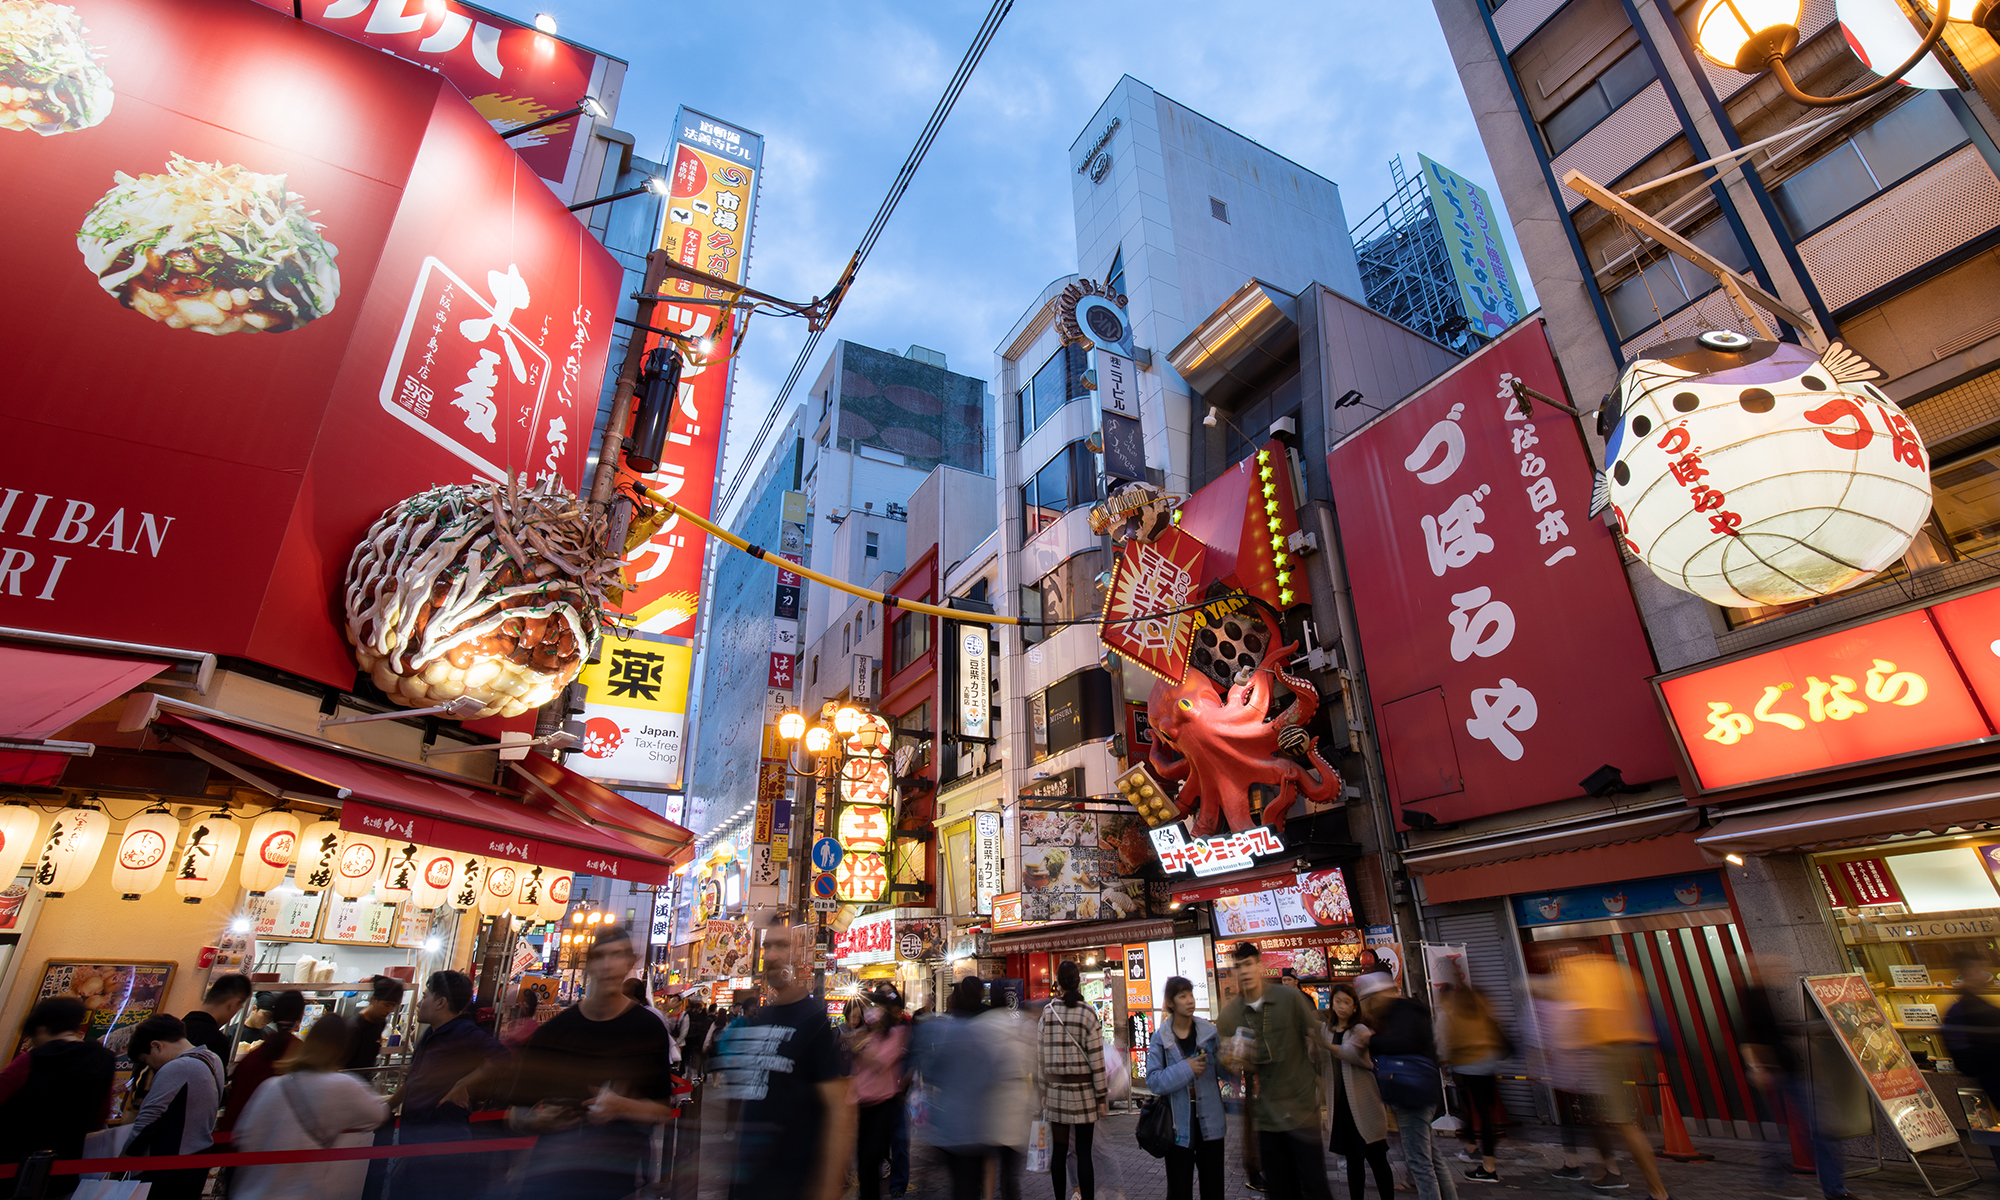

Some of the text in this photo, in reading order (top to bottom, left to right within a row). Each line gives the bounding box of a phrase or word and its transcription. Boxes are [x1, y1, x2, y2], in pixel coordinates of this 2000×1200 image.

[418, 283, 455, 380] 大阪西中島本店
[1657, 419, 1743, 538] づぼらや
[1107, 488, 1149, 514] MUSEUM
[1405, 402, 1538, 761] づぼらや
[782, 595, 794, 606] 刀
[606, 648, 666, 702] 薬
[773, 656, 791, 687] はや
[969, 659, 980, 708] 豆柴カフェ
[1703, 658, 1929, 746] ふぐなら
[634, 737, 678, 752] Tax-free
[640, 725, 679, 738] Japan.
[648, 751, 677, 764] Shop
[308, 833, 338, 888] たこ焼
[983, 838, 993, 889] 豆柴カフェ
[1160, 830, 1281, 871] コナモンミュージアム
[457, 858, 479, 906] たこ焼
[814, 901, 836, 910] 自動車
[1261, 937, 1303, 950] 自由席あります
[1307, 937, 1317, 946] Eat
[1323, 937, 1340, 946] space.
[1885, 920, 1993, 938] WELCOME
